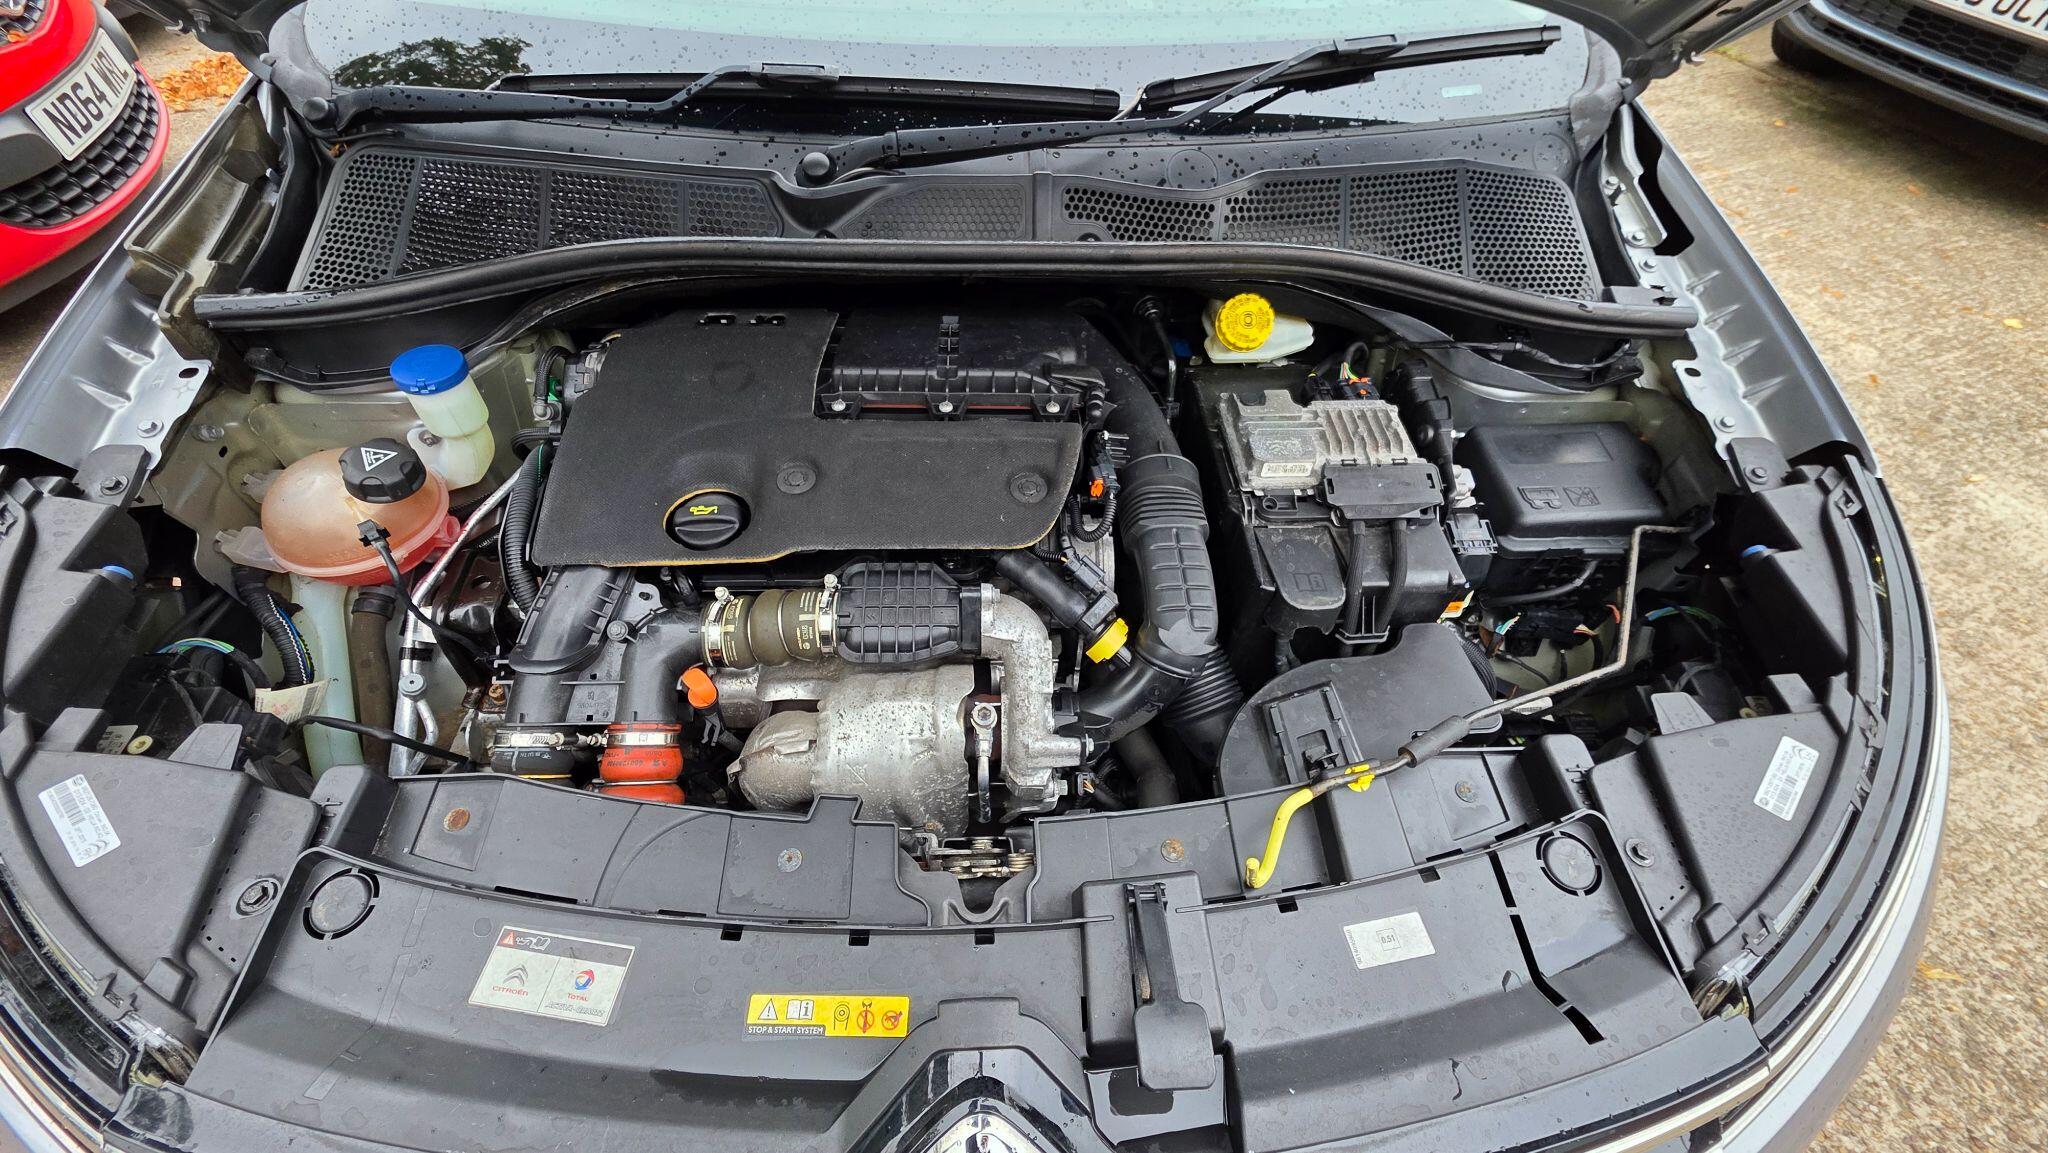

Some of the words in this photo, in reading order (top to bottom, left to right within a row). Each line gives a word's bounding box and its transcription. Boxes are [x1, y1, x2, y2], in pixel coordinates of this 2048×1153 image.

[42, 71, 112, 146] ND64
[90, 45, 129, 98] WRL
[567, 992, 589, 1002] TOTAL
[748, 1026, 767, 1034] STOP
[767, 1026, 773, 1034] &
[774, 1026, 796, 1034] START
[796, 1026, 824, 1035] SYSTEM
